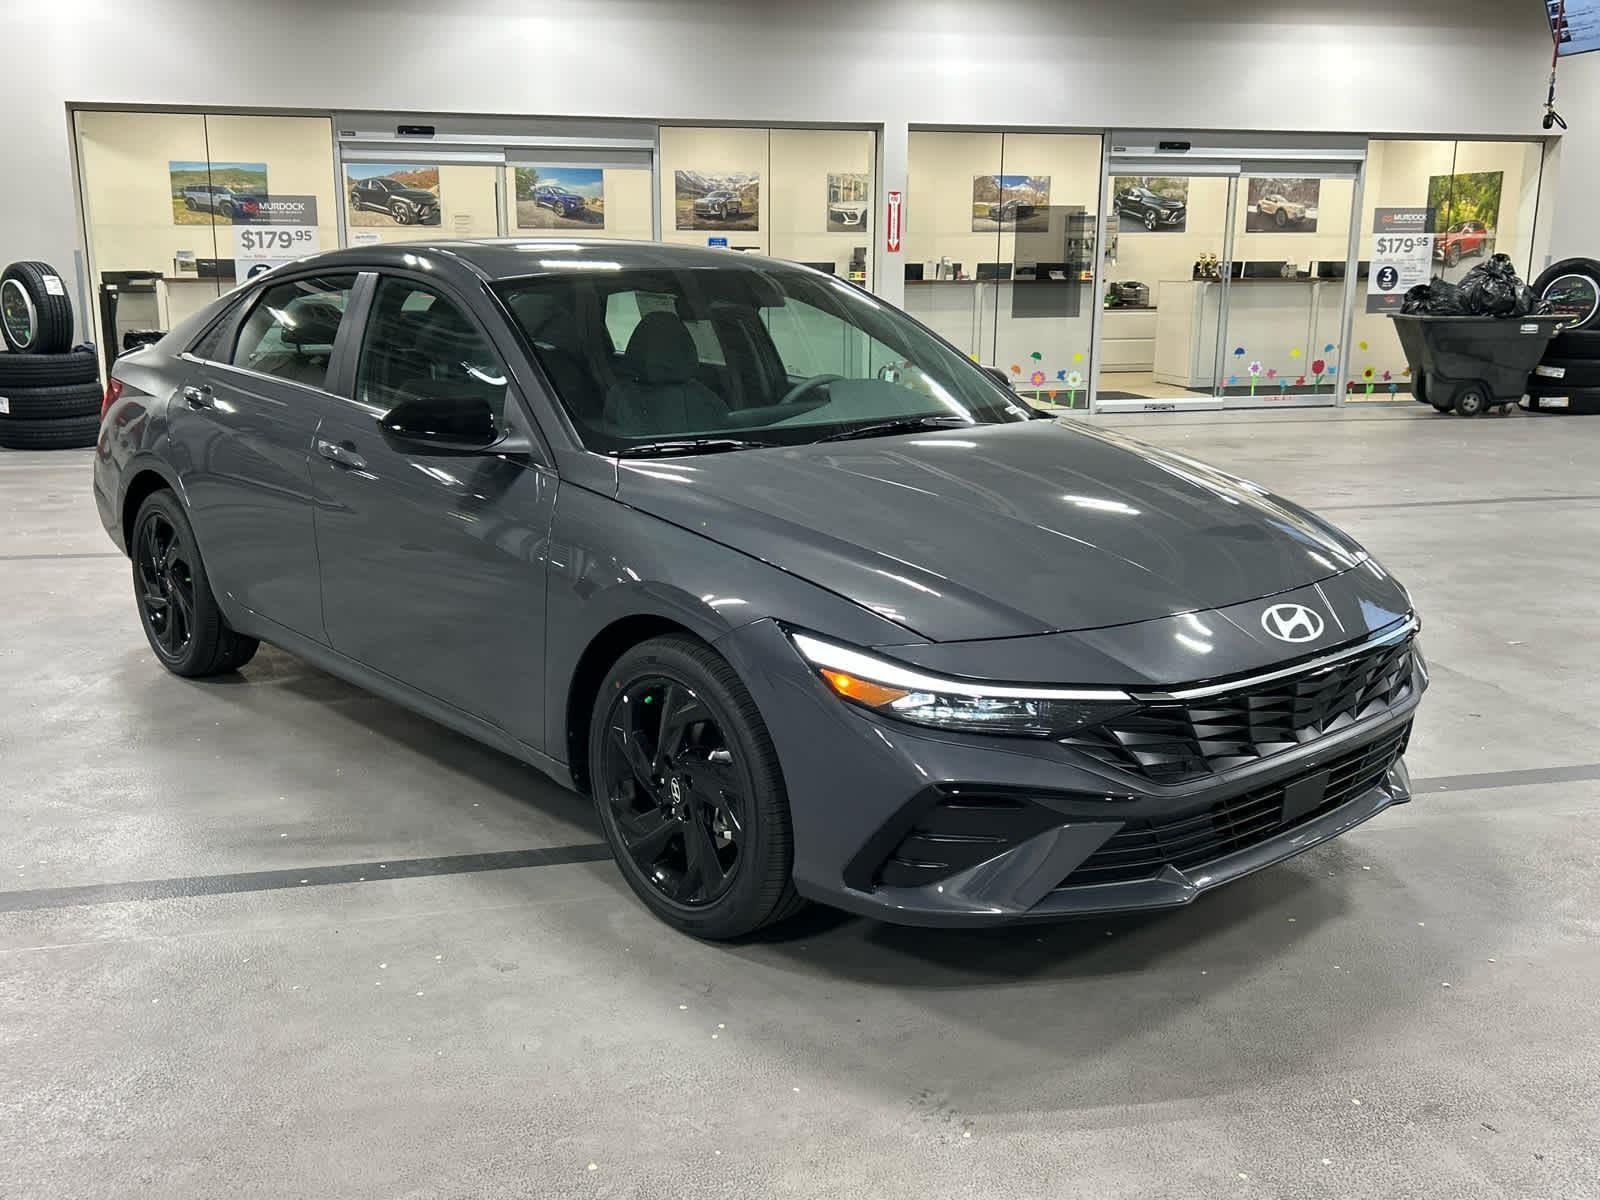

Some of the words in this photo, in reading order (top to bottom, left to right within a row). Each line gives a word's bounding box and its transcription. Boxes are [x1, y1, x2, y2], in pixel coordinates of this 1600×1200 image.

[259, 202, 304, 210] MURDOCK
[241, 230, 312, 250] $179.95
[1382, 268, 1393, 281] 3
